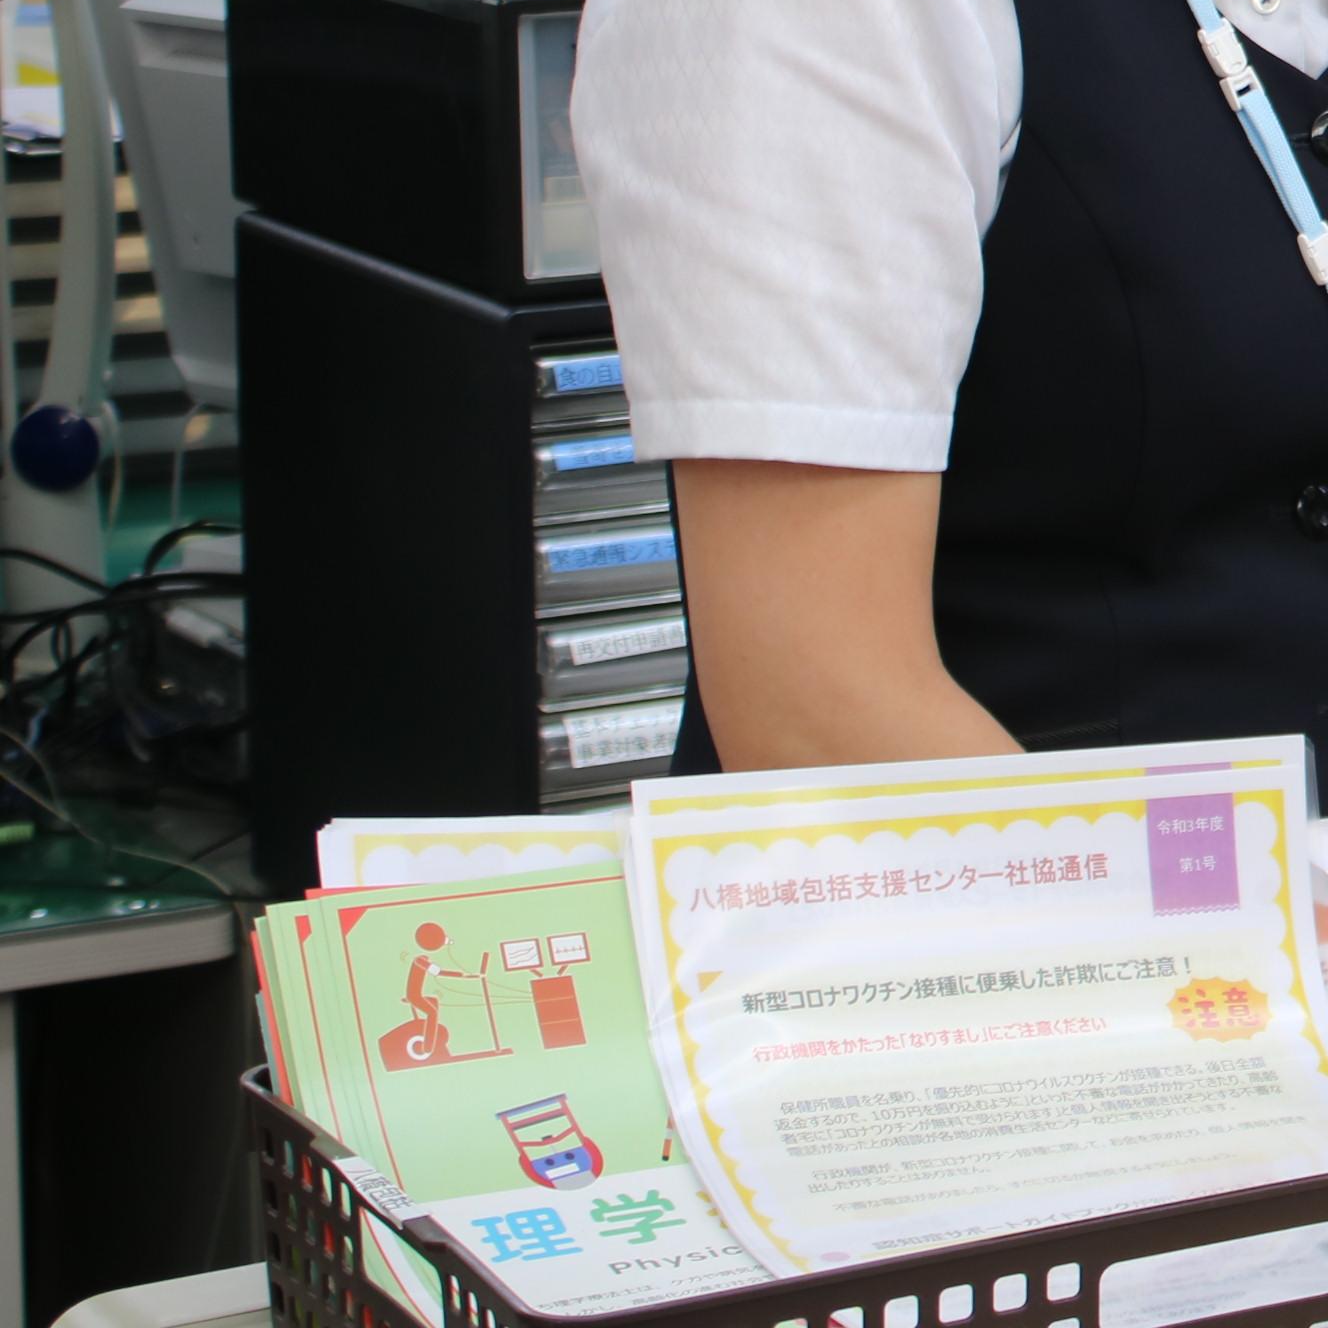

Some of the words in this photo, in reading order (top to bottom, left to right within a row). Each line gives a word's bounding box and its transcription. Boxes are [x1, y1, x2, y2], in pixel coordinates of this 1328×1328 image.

[559, 363, 621, 387] 食の自
[1157, 815, 1225, 835] 令和3年度
[690, 853, 1109, 912] 八橋地域包括支援センター社協通信
[1179, 855, 1217, 873] 第1号
[742, 956, 1192, 1014] 新型コロナワクチン接種に便乗した詐欺にご注意！
[1177, 987, 1263, 1030] 注意
[753, 1017, 1107, 1063] 行政機関をかたった「なりすまし」にご注意ください
[471, 1189, 730, 1264] 理学
